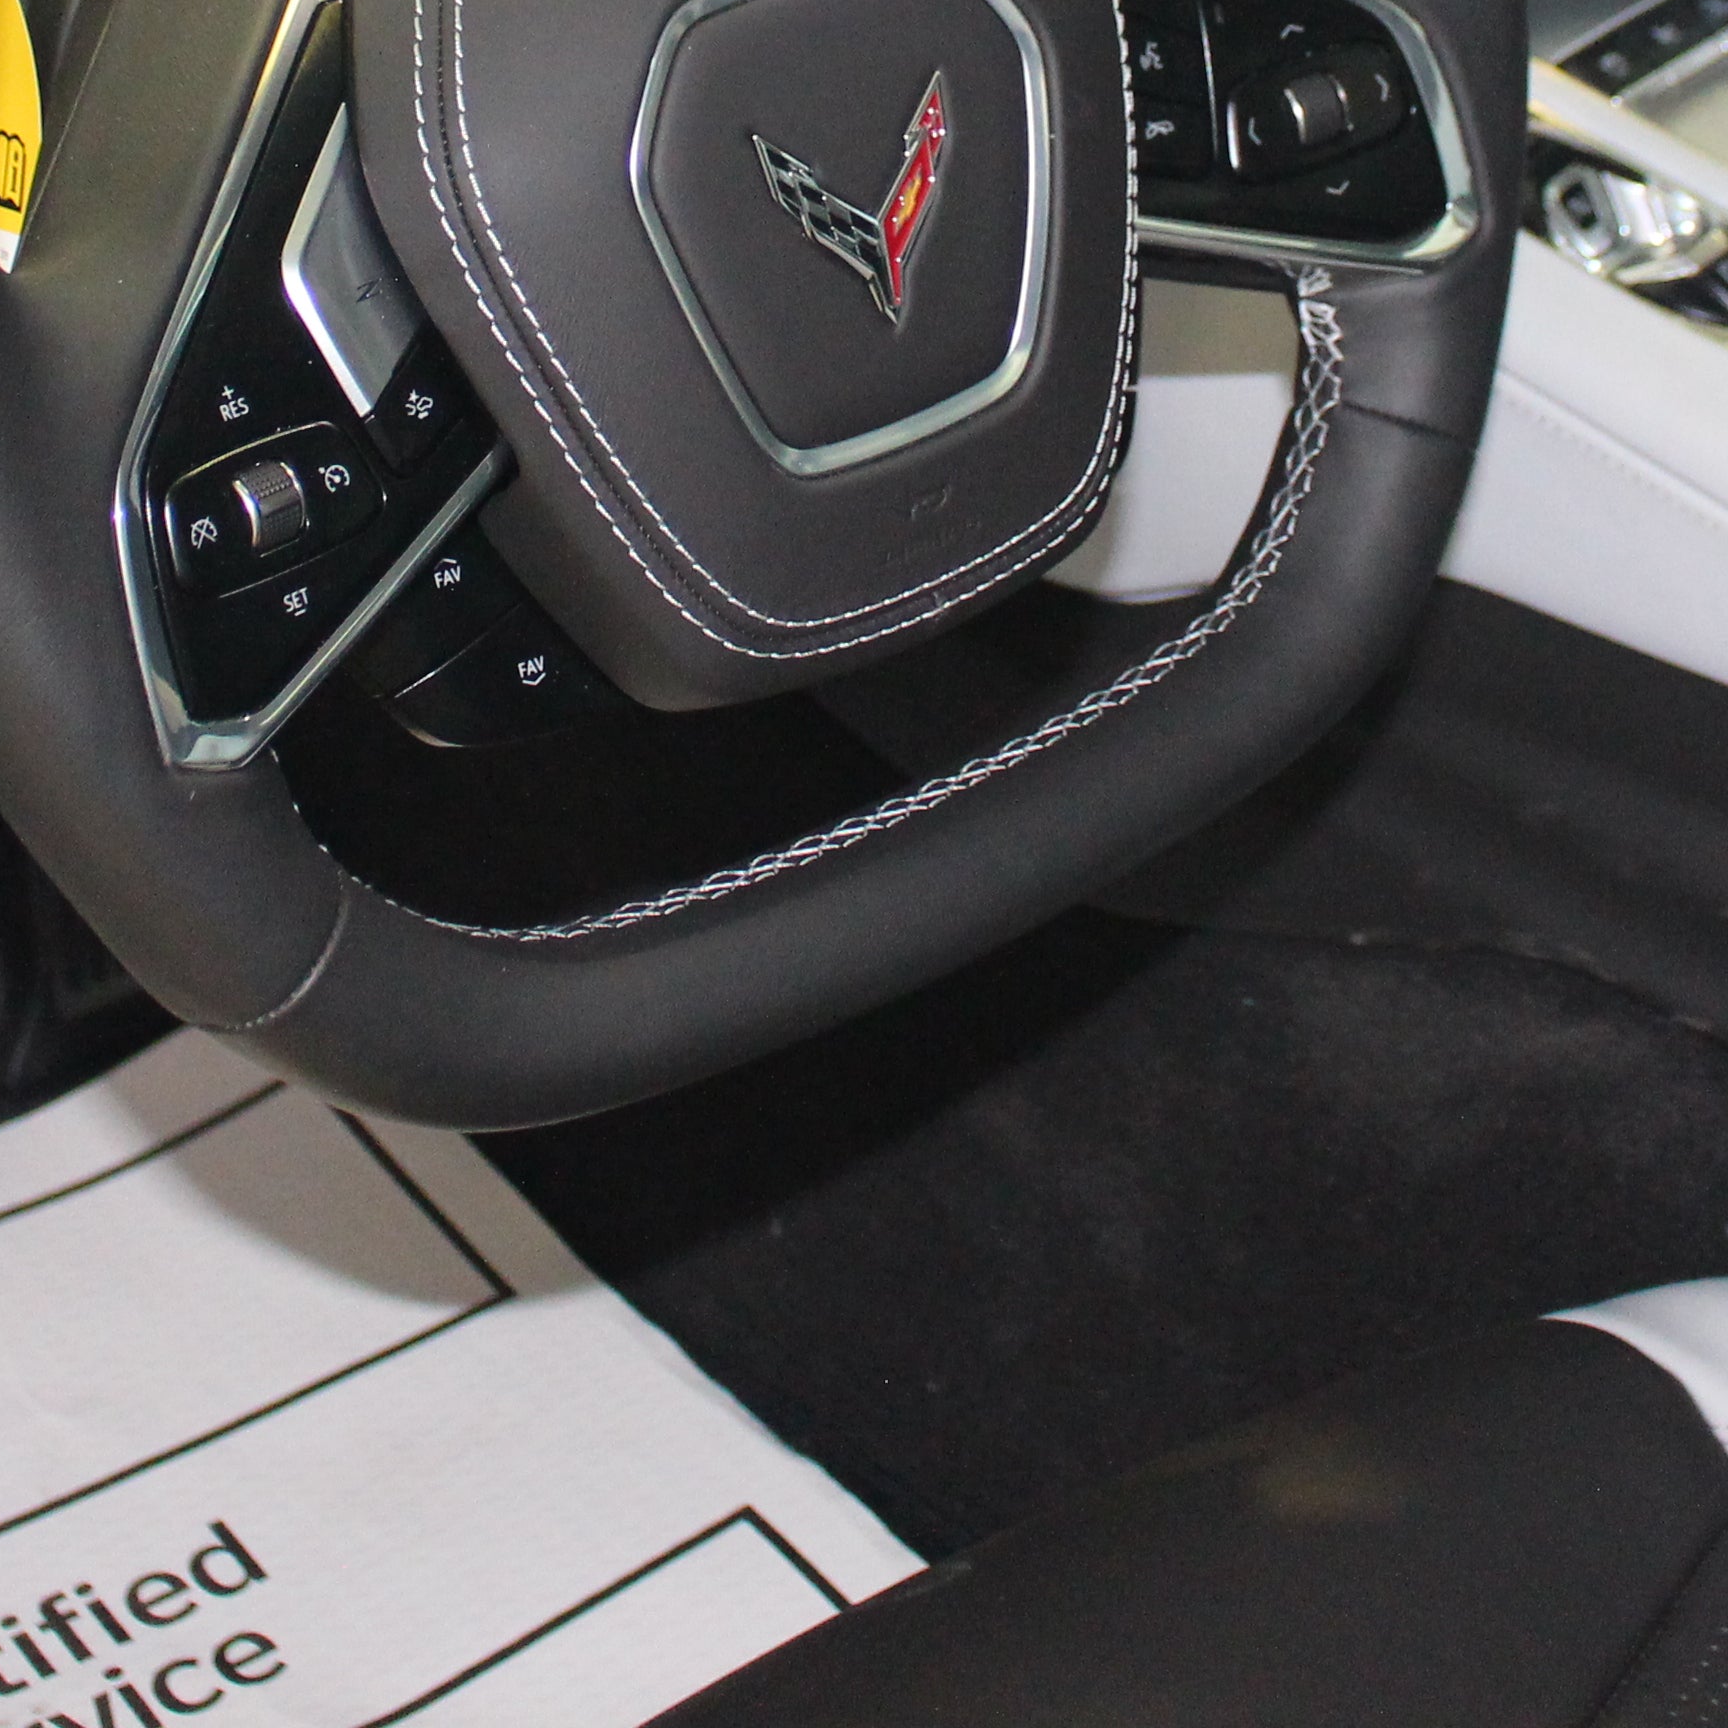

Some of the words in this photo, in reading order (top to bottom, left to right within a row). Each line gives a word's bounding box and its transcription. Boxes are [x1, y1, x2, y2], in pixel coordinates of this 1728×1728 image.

[218, 395, 250, 422] RES
[433, 565, 462, 589] FAV
[282, 587, 309, 612] SET
[517, 655, 545, 678] FAV
